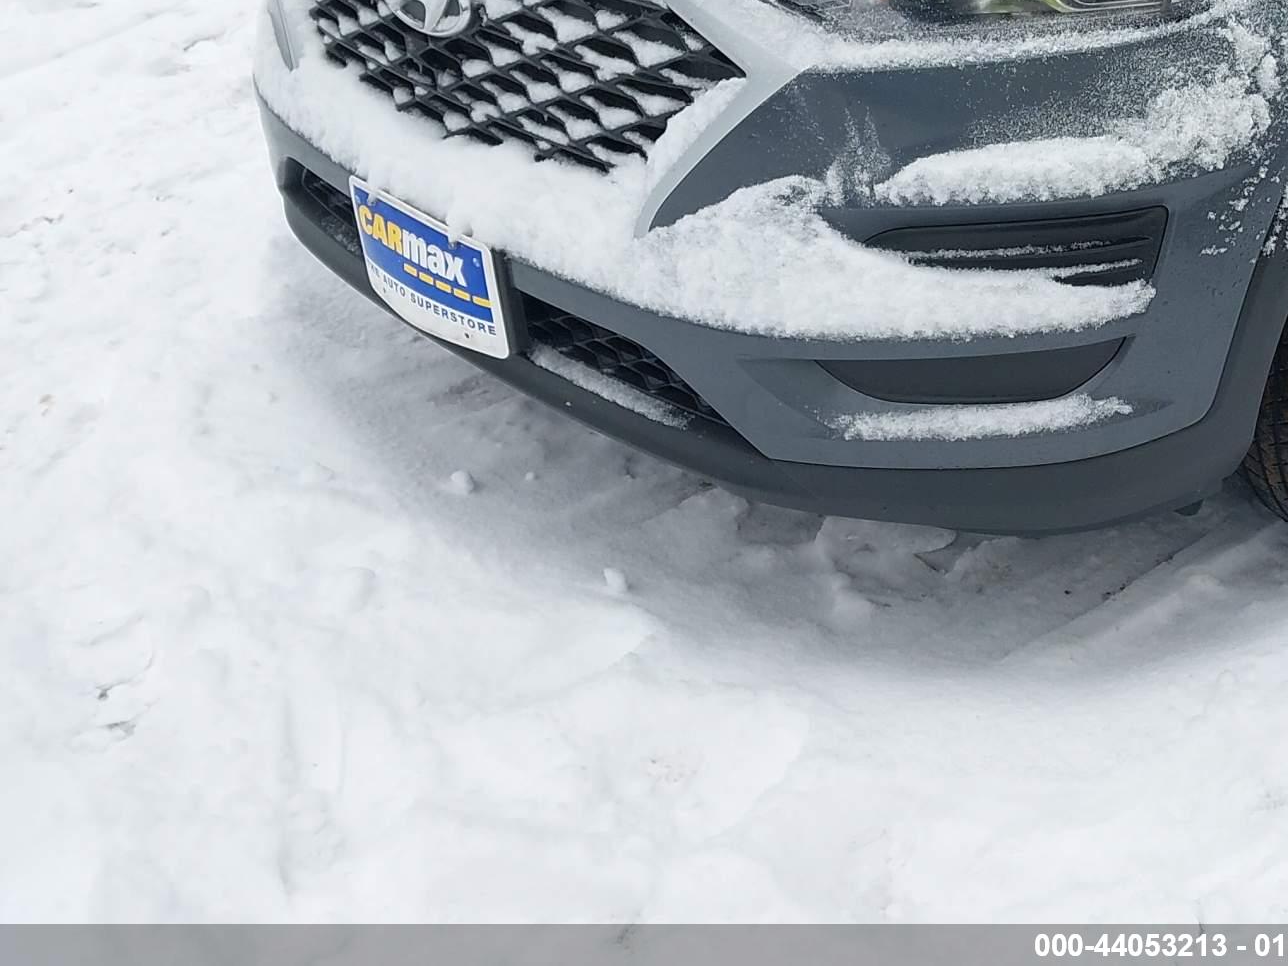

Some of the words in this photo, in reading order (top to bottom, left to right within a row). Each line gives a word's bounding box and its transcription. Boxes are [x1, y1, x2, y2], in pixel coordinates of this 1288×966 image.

[358, 205, 468, 287] CARmax
[383, 273, 406, 297] AUTO
[410, 292, 497, 336] SUPERSTORE
